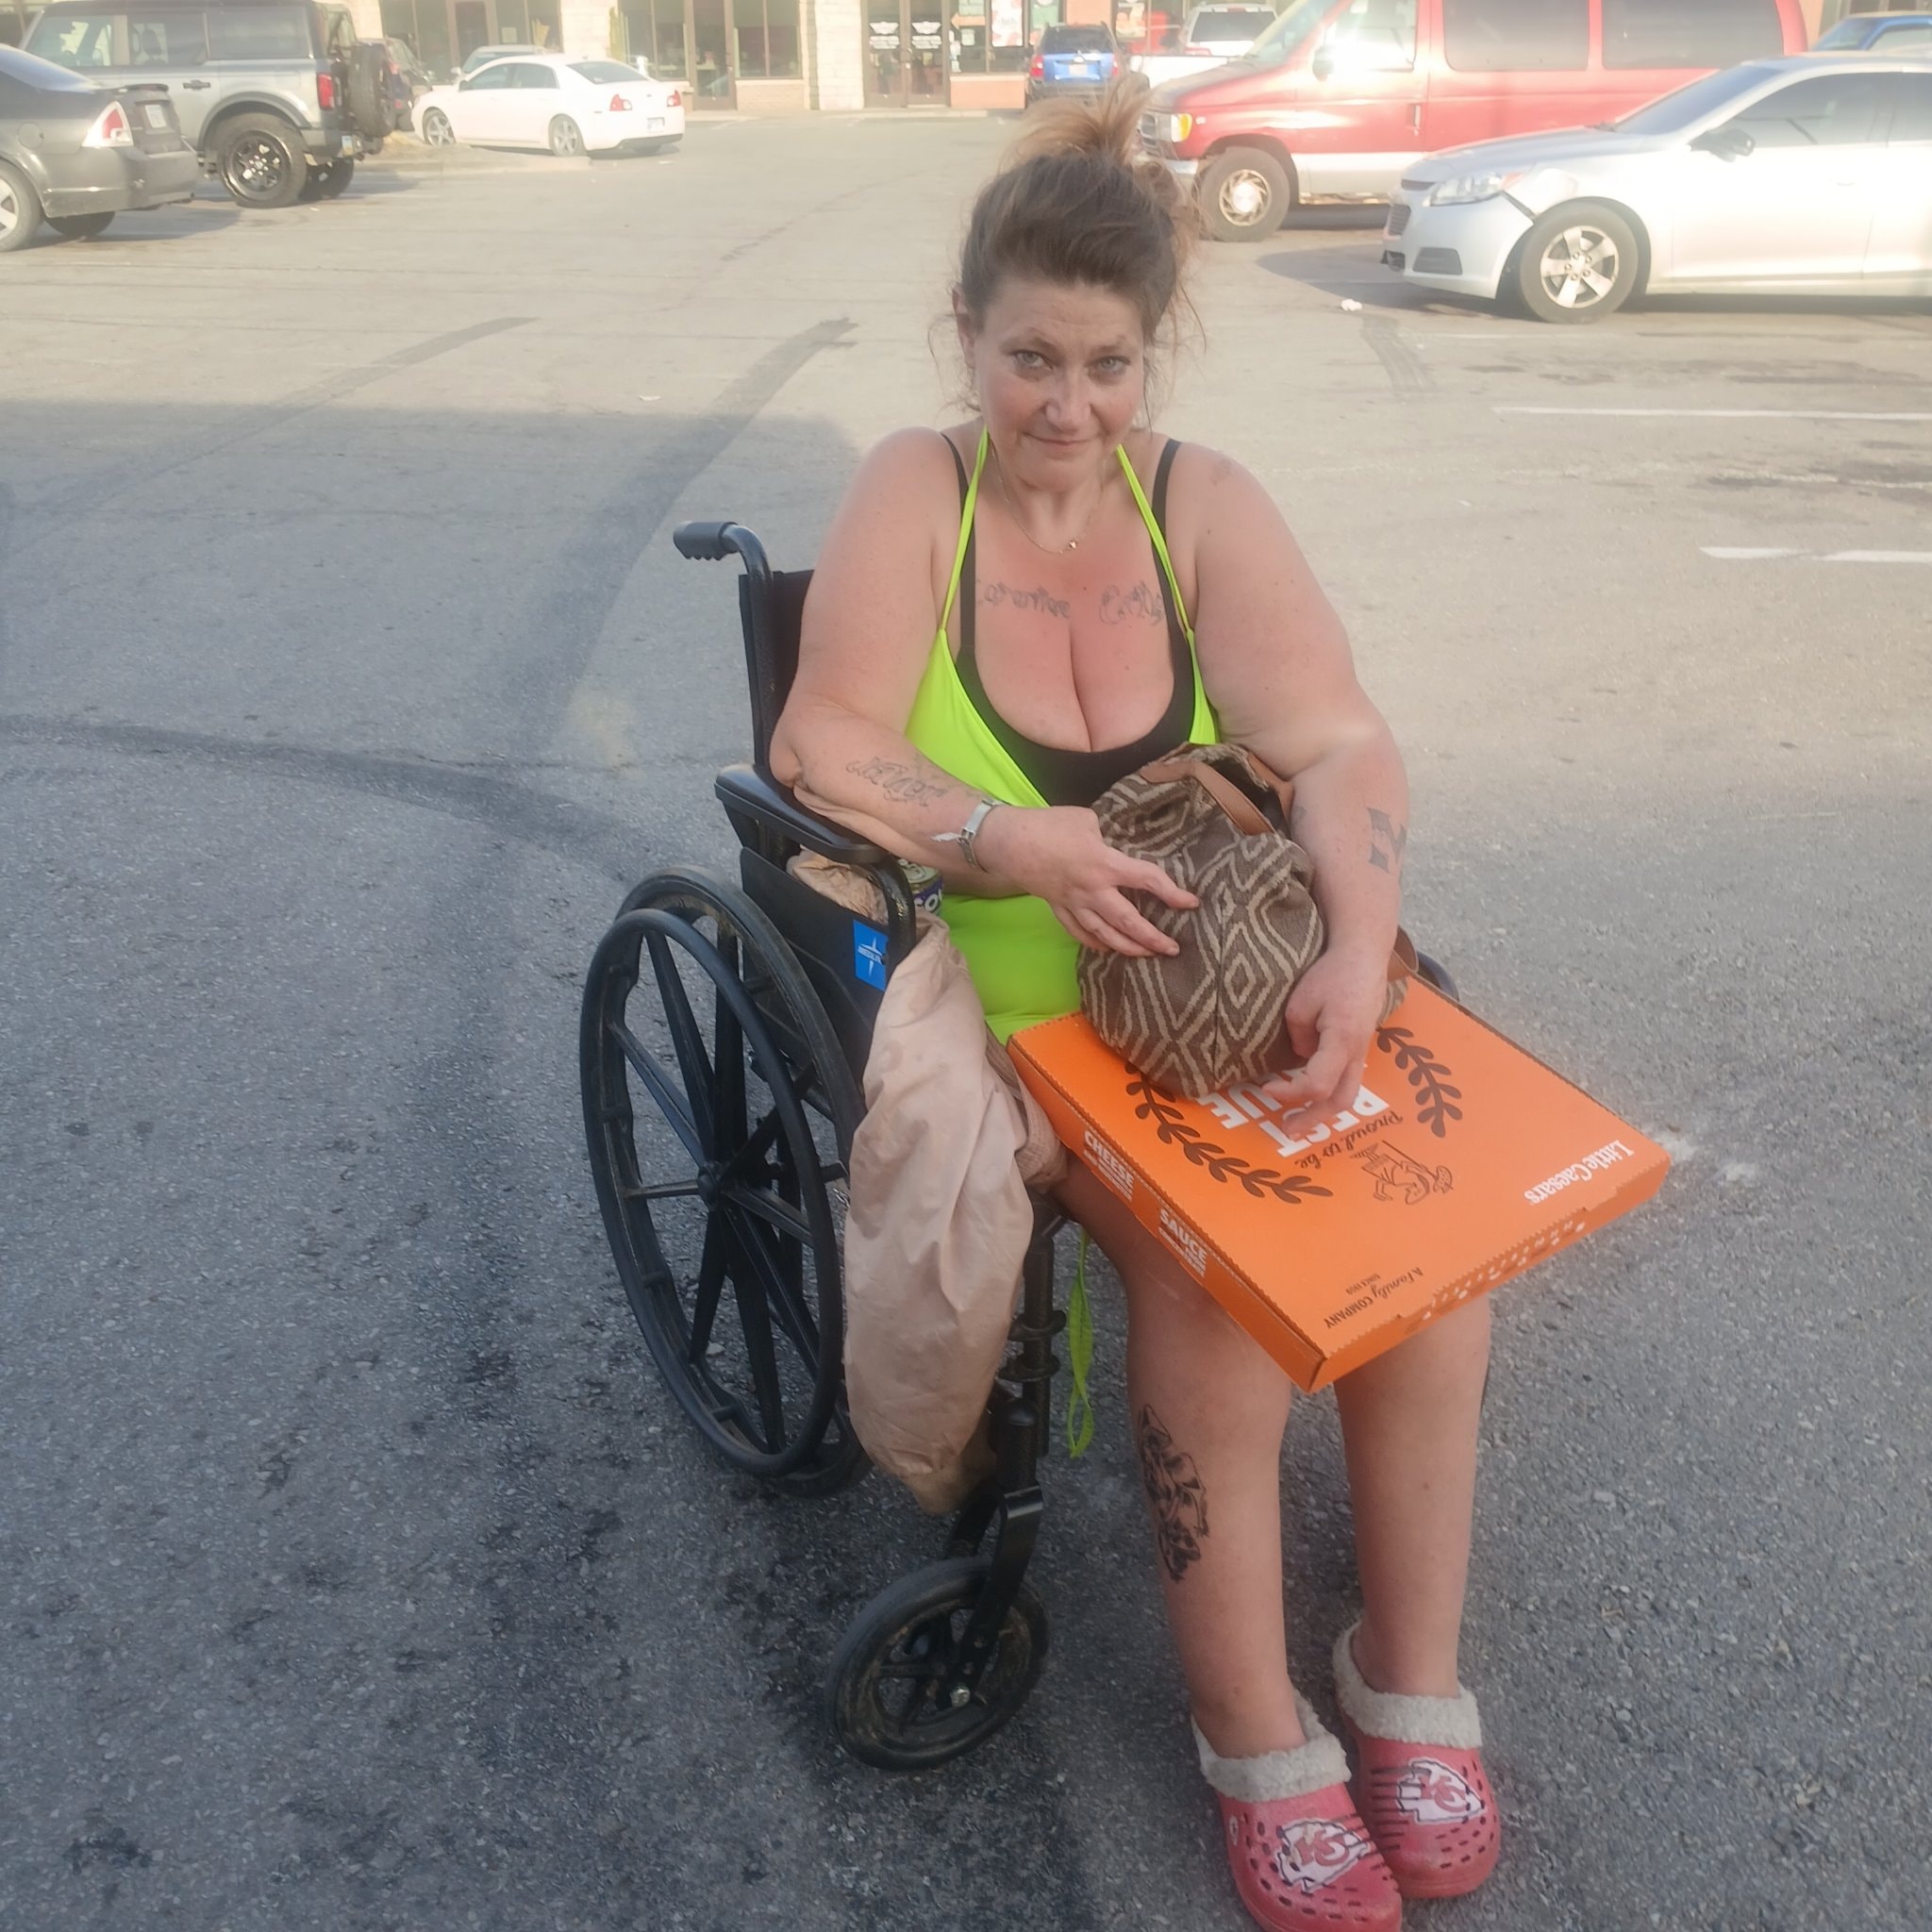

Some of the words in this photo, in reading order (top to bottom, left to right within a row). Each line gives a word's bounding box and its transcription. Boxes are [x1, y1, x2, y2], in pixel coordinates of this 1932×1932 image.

[1323, 1141, 1341, 1157] to
[1341, 1110, 1404, 1151] Proud
[1084, 1130, 1134, 1187] CHEESE
[1294, 1152, 1323, 1170] be
[1582, 1139, 1635, 1170] Little
[1524, 1162, 1592, 1205] Caesars
[1159, 1208, 1208, 1265] SAUCE
[1371, 1271, 1414, 1299] Family
[1324, 1295, 1374, 1329] COMPANY
[1419, 1774, 1468, 1813] KC
[1293, 1826, 1350, 1867] KC
